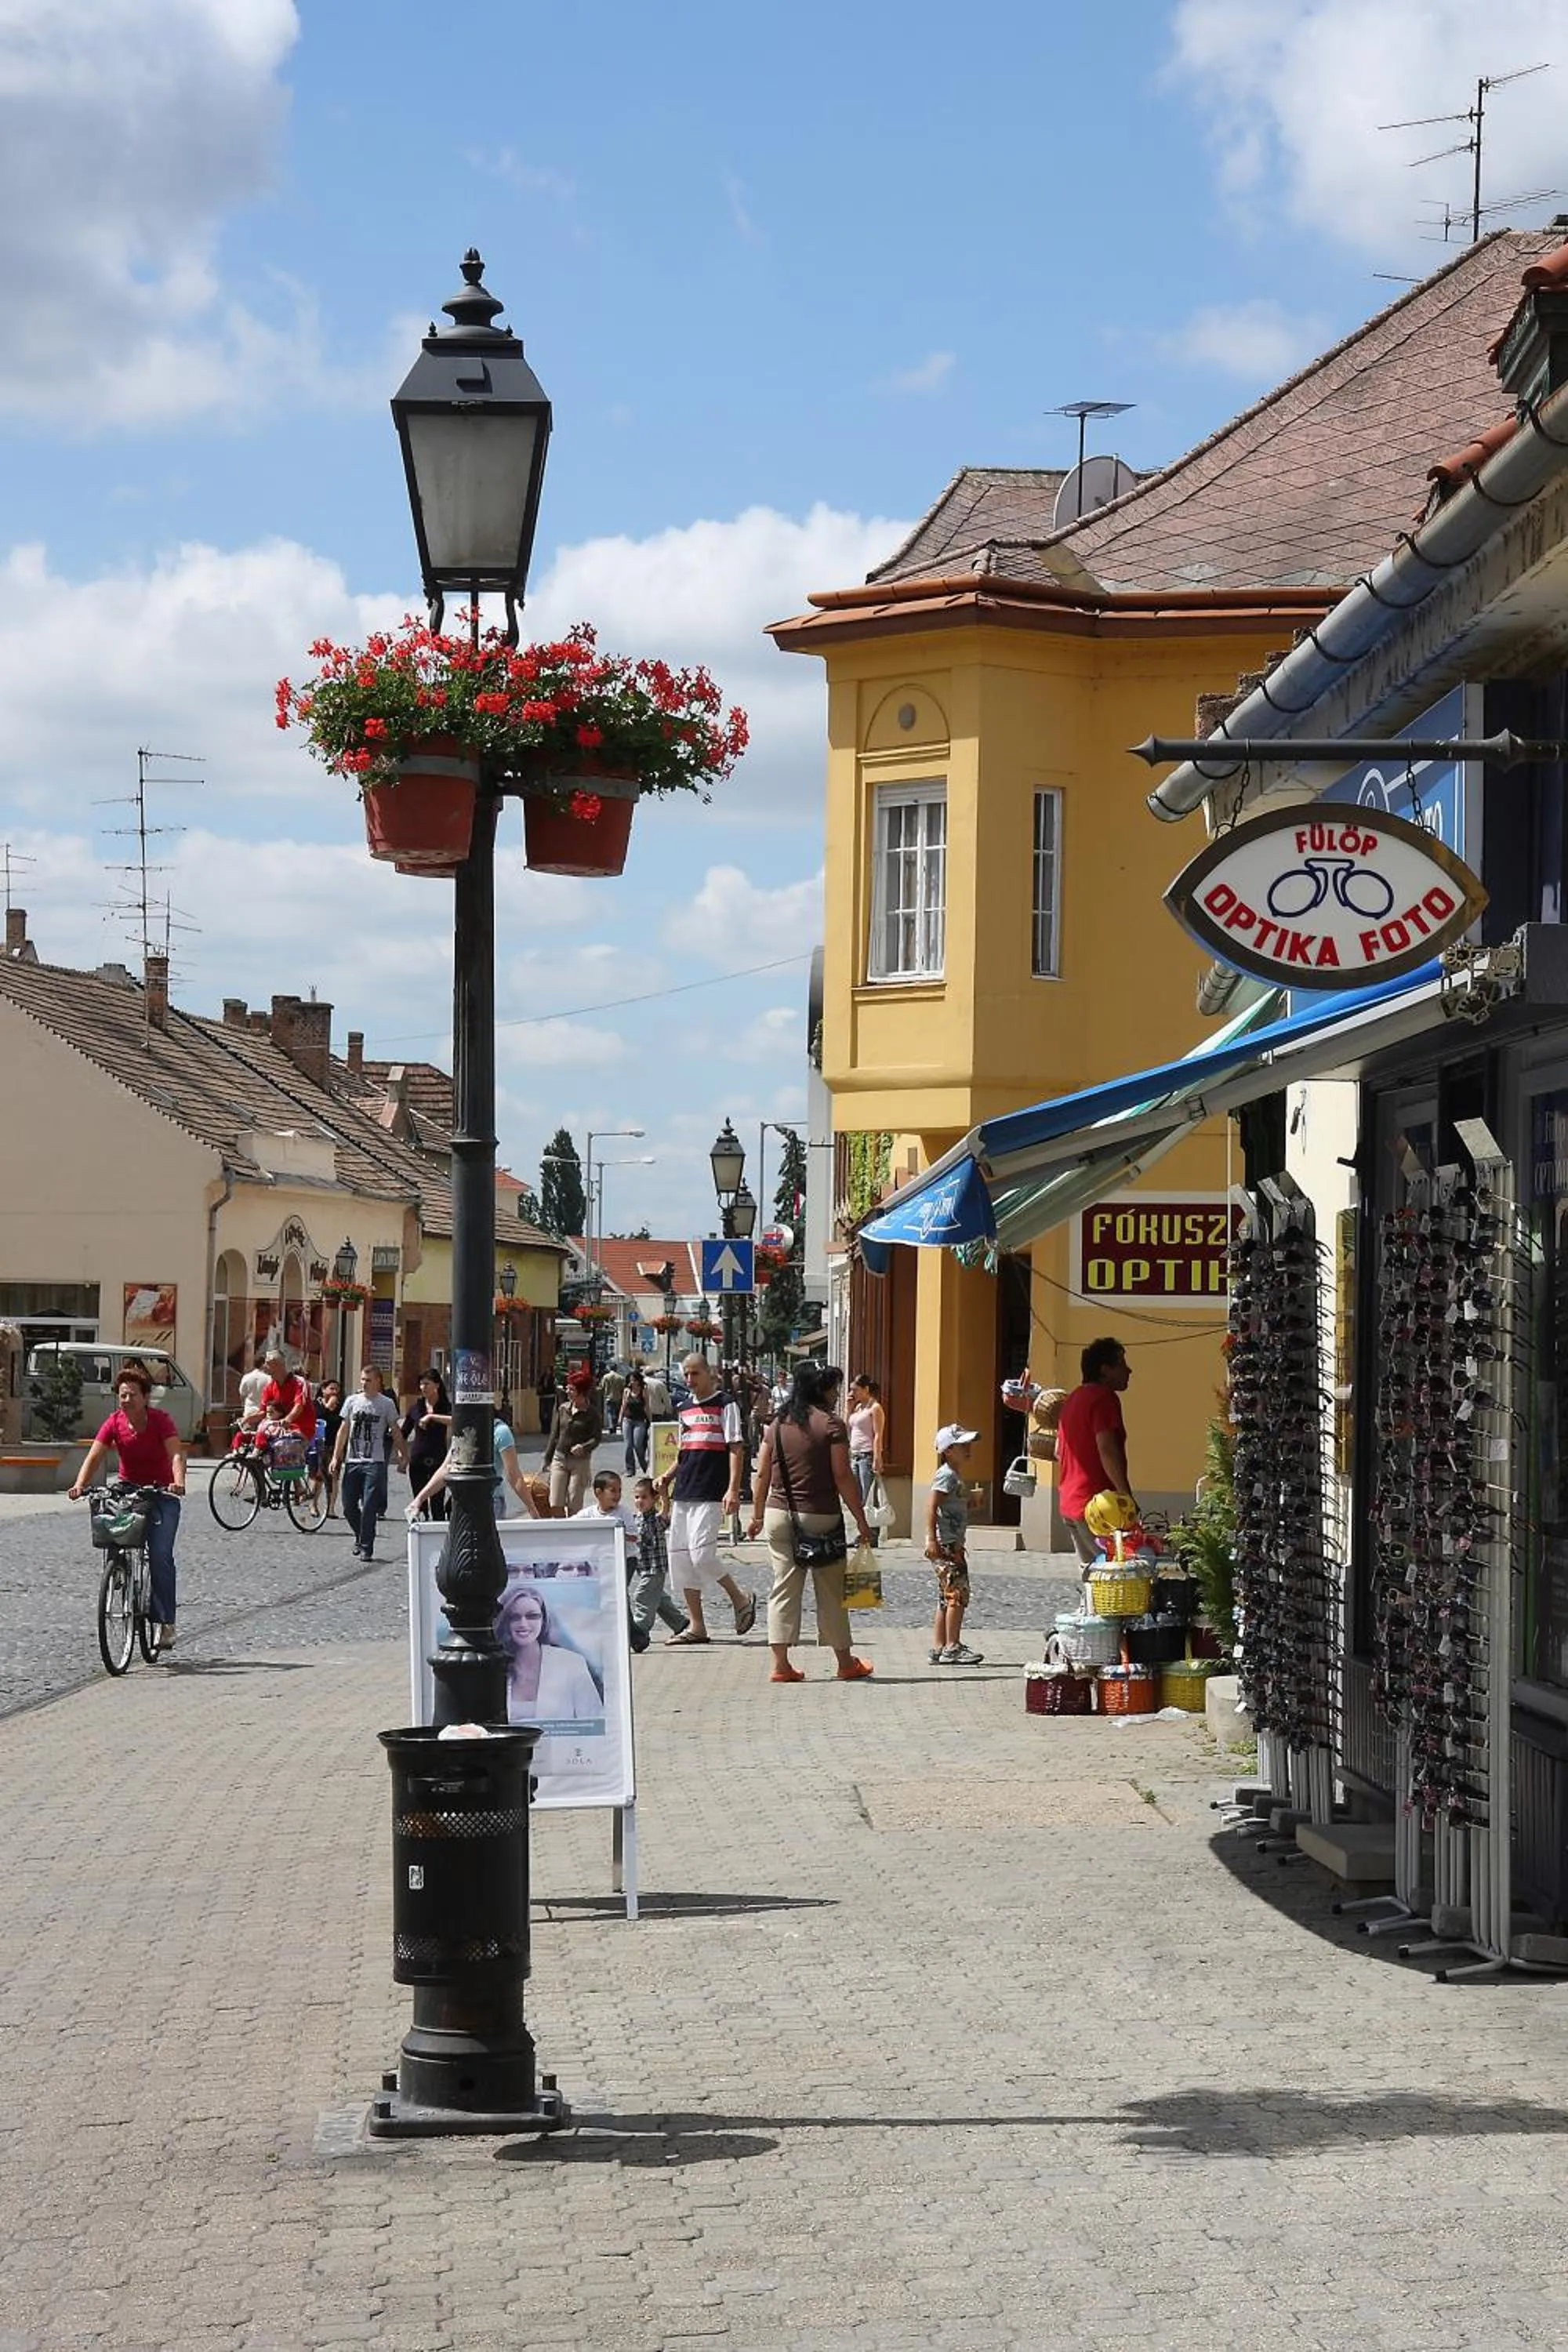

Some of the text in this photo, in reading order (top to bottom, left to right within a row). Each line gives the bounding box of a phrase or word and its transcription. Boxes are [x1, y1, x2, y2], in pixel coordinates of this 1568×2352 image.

[1295, 822, 1378, 856] FÜLÖP
[1203, 884, 1456, 967] OPTIKA FOTO
[1092, 1208, 1228, 1246] FÓKUSZ
